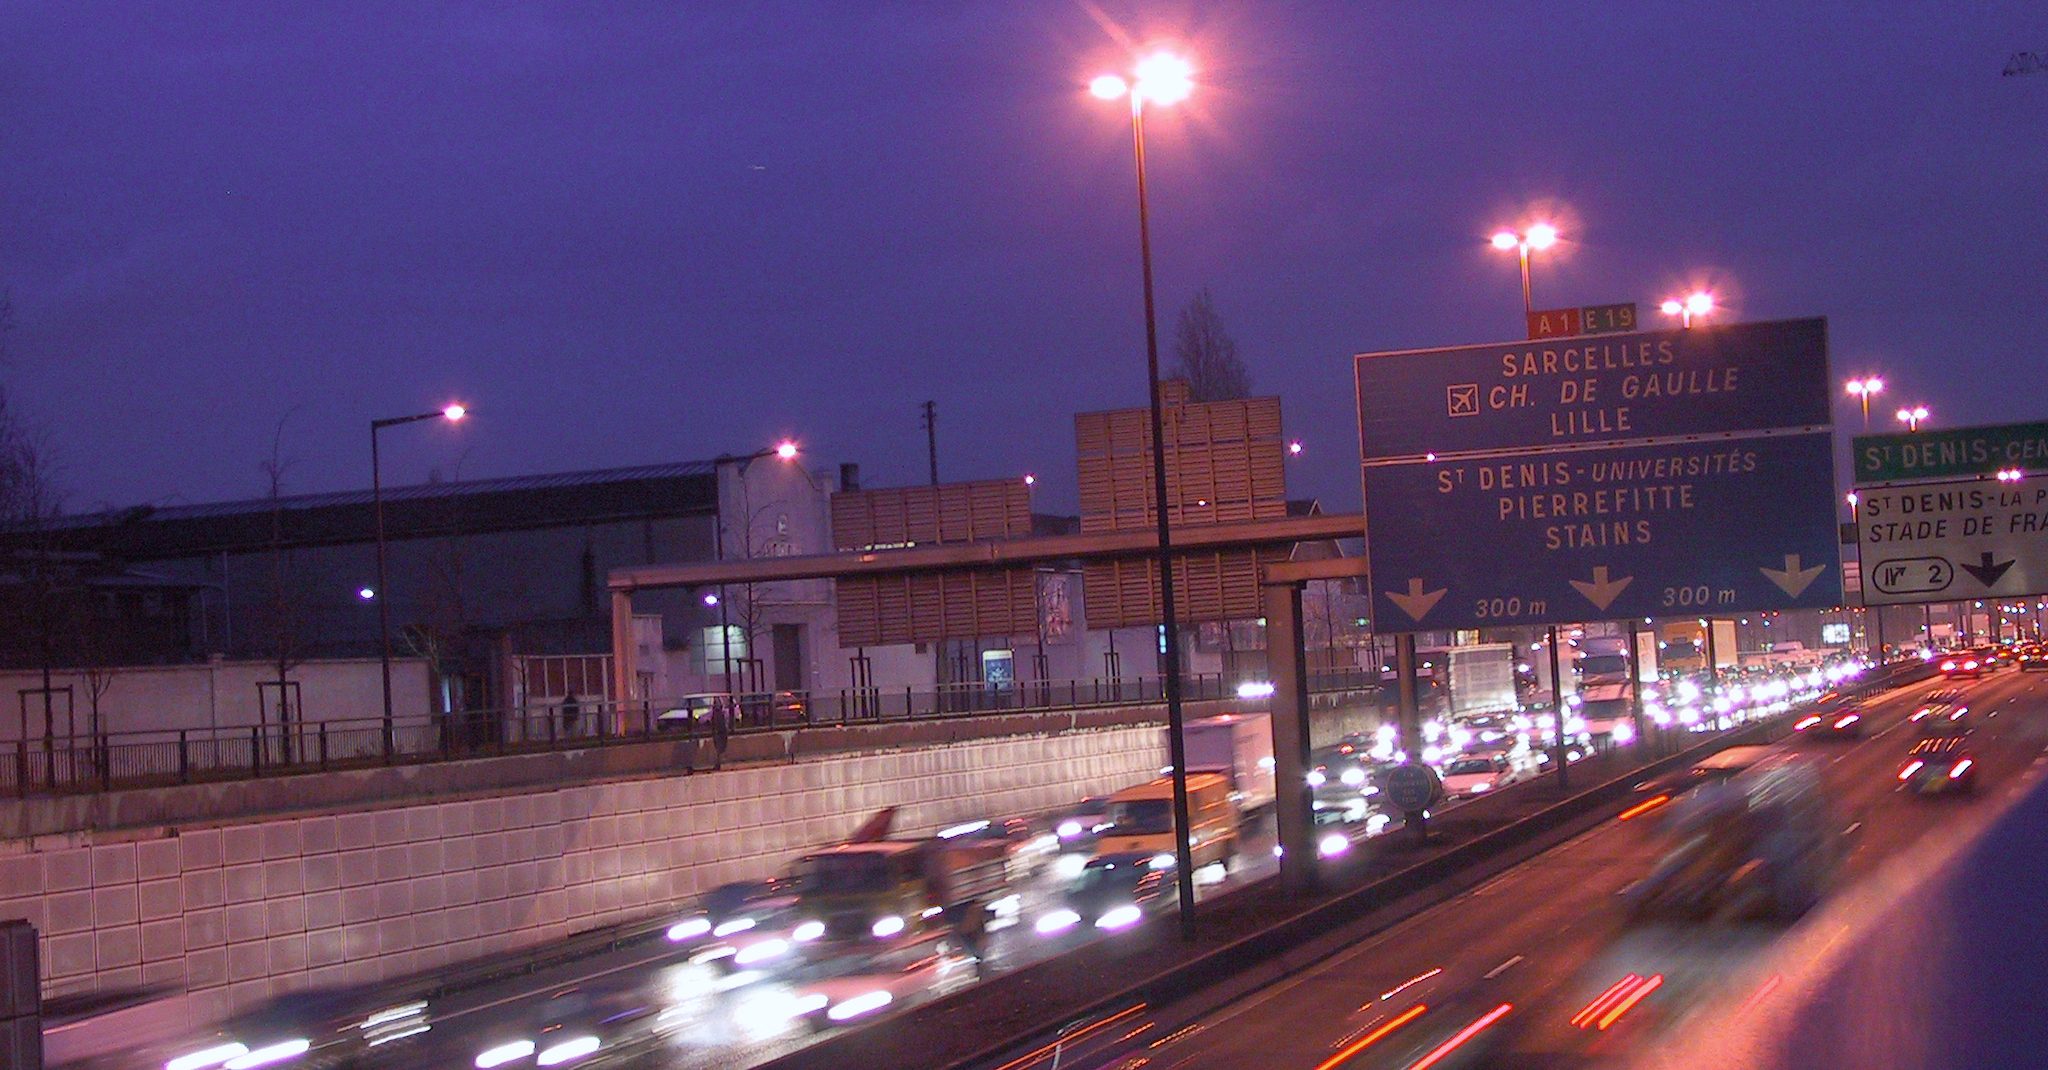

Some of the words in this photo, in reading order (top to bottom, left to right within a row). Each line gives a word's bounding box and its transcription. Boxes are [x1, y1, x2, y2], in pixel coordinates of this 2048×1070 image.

[1539, 316, 1551, 333] A
[1560, 313, 1568, 331] 1
[1586, 310, 1596, 329] E
[1606, 306, 1632, 327] 19
[1503, 341, 1674, 377] SARCELLES
[1489, 384, 1536, 409] CH.
[1561, 379, 1598, 404] DE
[1622, 367, 1739, 399] GAULLE
[1552, 407, 1632, 436] LILLE
[1500, 484, 1694, 520] PIERREFITTE
[1546, 520, 1652, 549] STAINS
[1869, 519, 1947, 543] STADE
[1963, 516, 1993, 537] DE
[1928, 565, 1942, 583] 2
[1475, 597, 1521, 618] 300
[1528, 600, 1547, 615] m
[1662, 586, 1710, 607] 300
[1717, 589, 1736, 603] m
